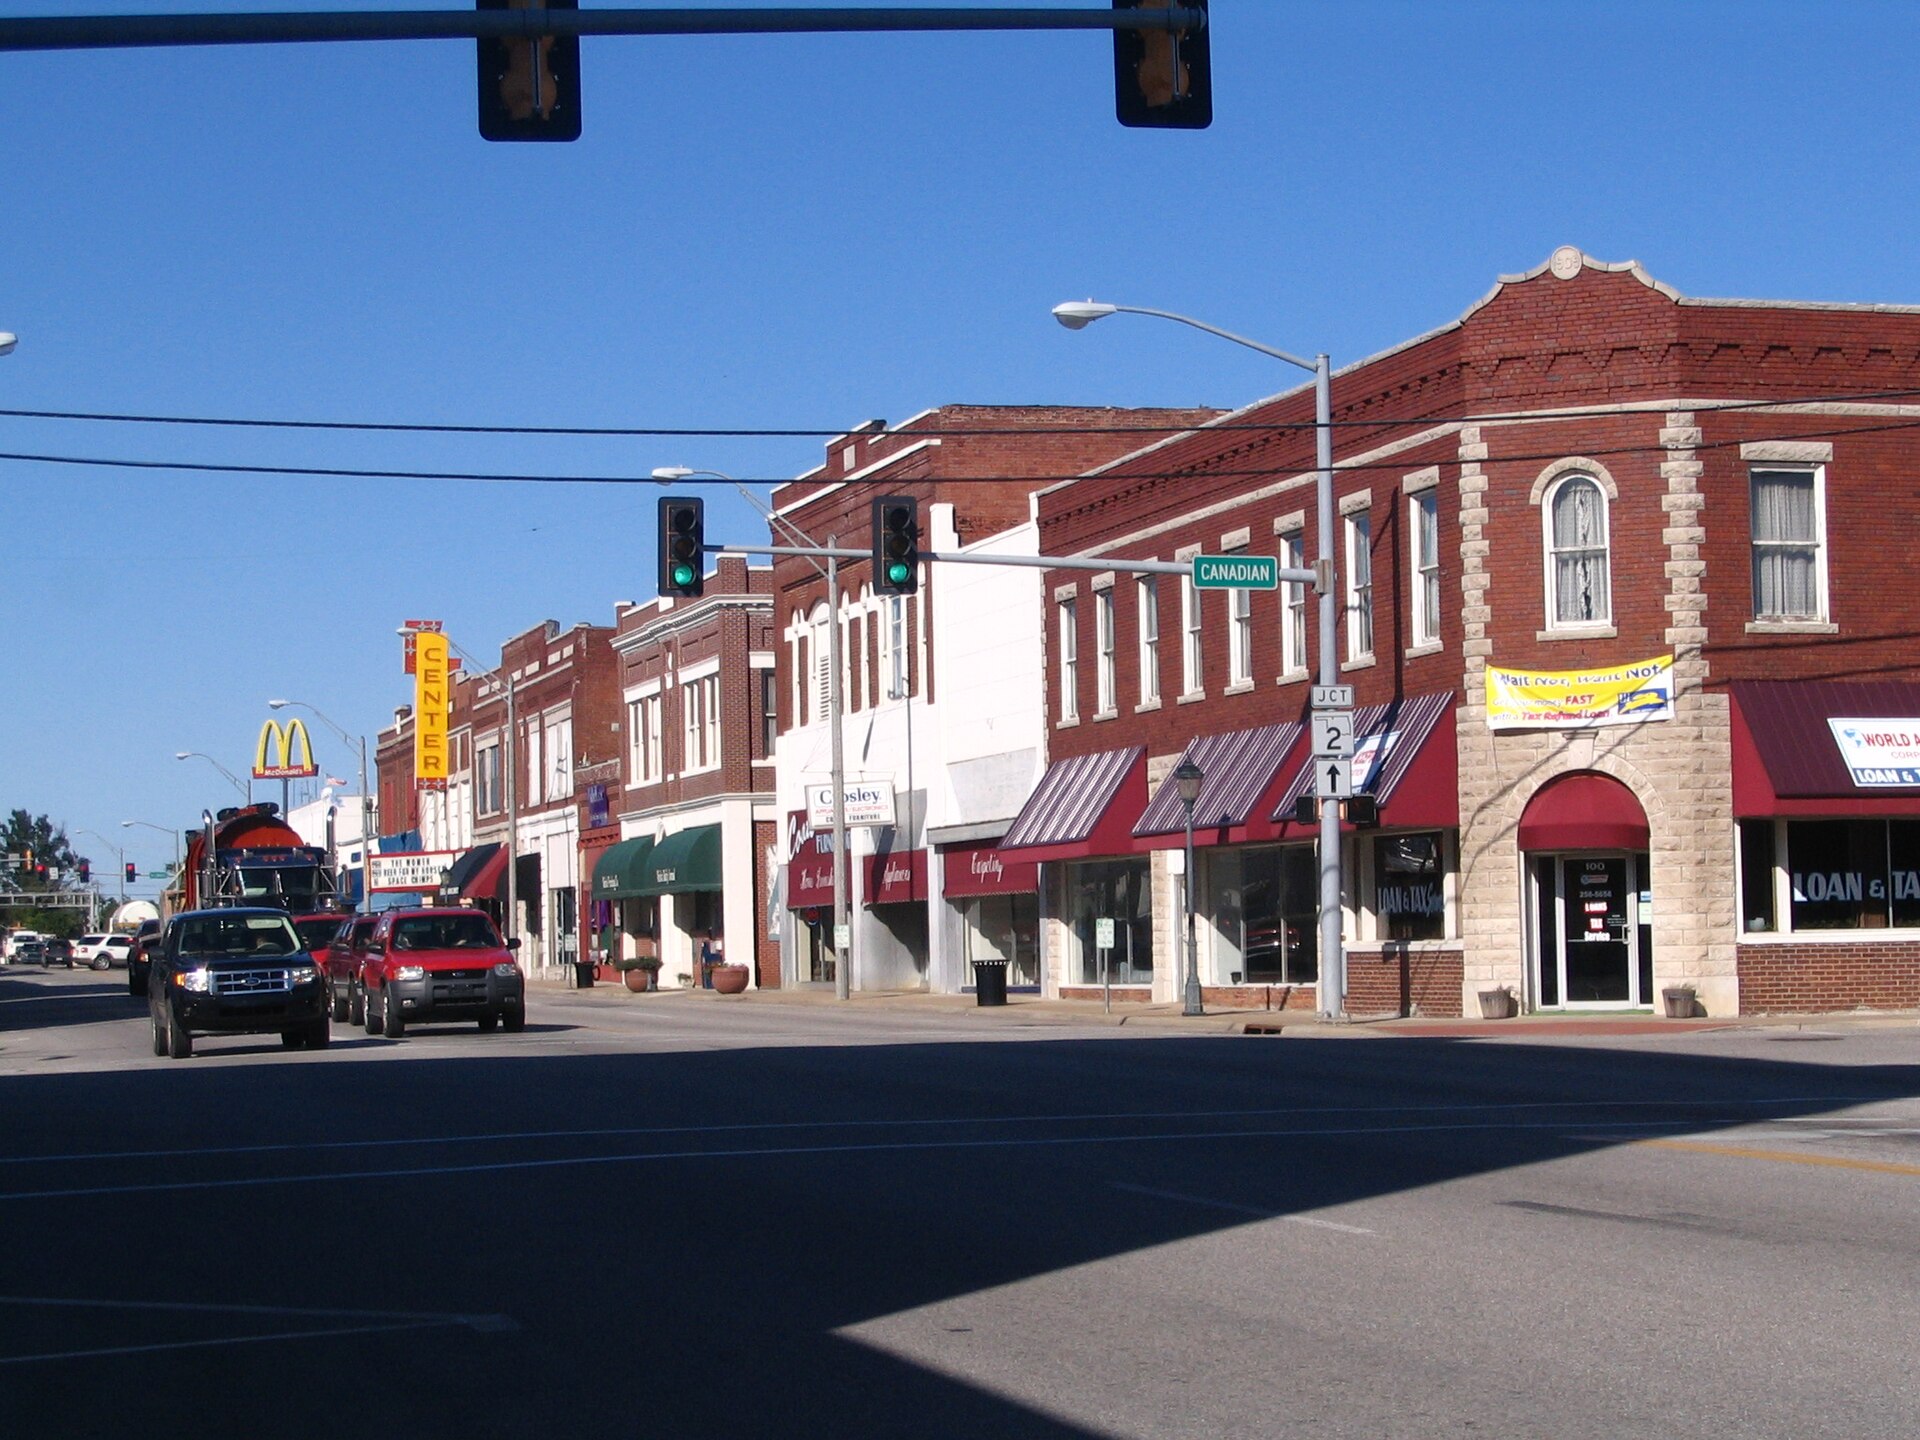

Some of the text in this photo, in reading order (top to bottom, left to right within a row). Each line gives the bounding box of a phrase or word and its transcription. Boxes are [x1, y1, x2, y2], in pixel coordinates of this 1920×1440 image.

[1201, 564, 1270, 581] CANADIAN
[1318, 690, 1347, 702] JCT
[1565, 694, 1594, 705] FAST
[424, 648, 441, 770] CENTER
[1522, 711, 1541, 720] Tax
[1544, 709, 1582, 722] Refund
[1326, 727, 1342, 750] 2
[1861, 733, 1911, 747] WORLD
[1856, 769, 1900, 783] LOAN
[1902, 771, 1914, 782] &
[392, 857, 430, 867] THE WOMEN
[388, 876, 407, 885] SPACE
[1794, 872, 1863, 901] LOAN
[1869, 879, 1885, 899] &
[1378, 887, 1402, 912] LOAN
[1410, 886, 1427, 912] TAX
[1584, 931, 1610, 942] Service
